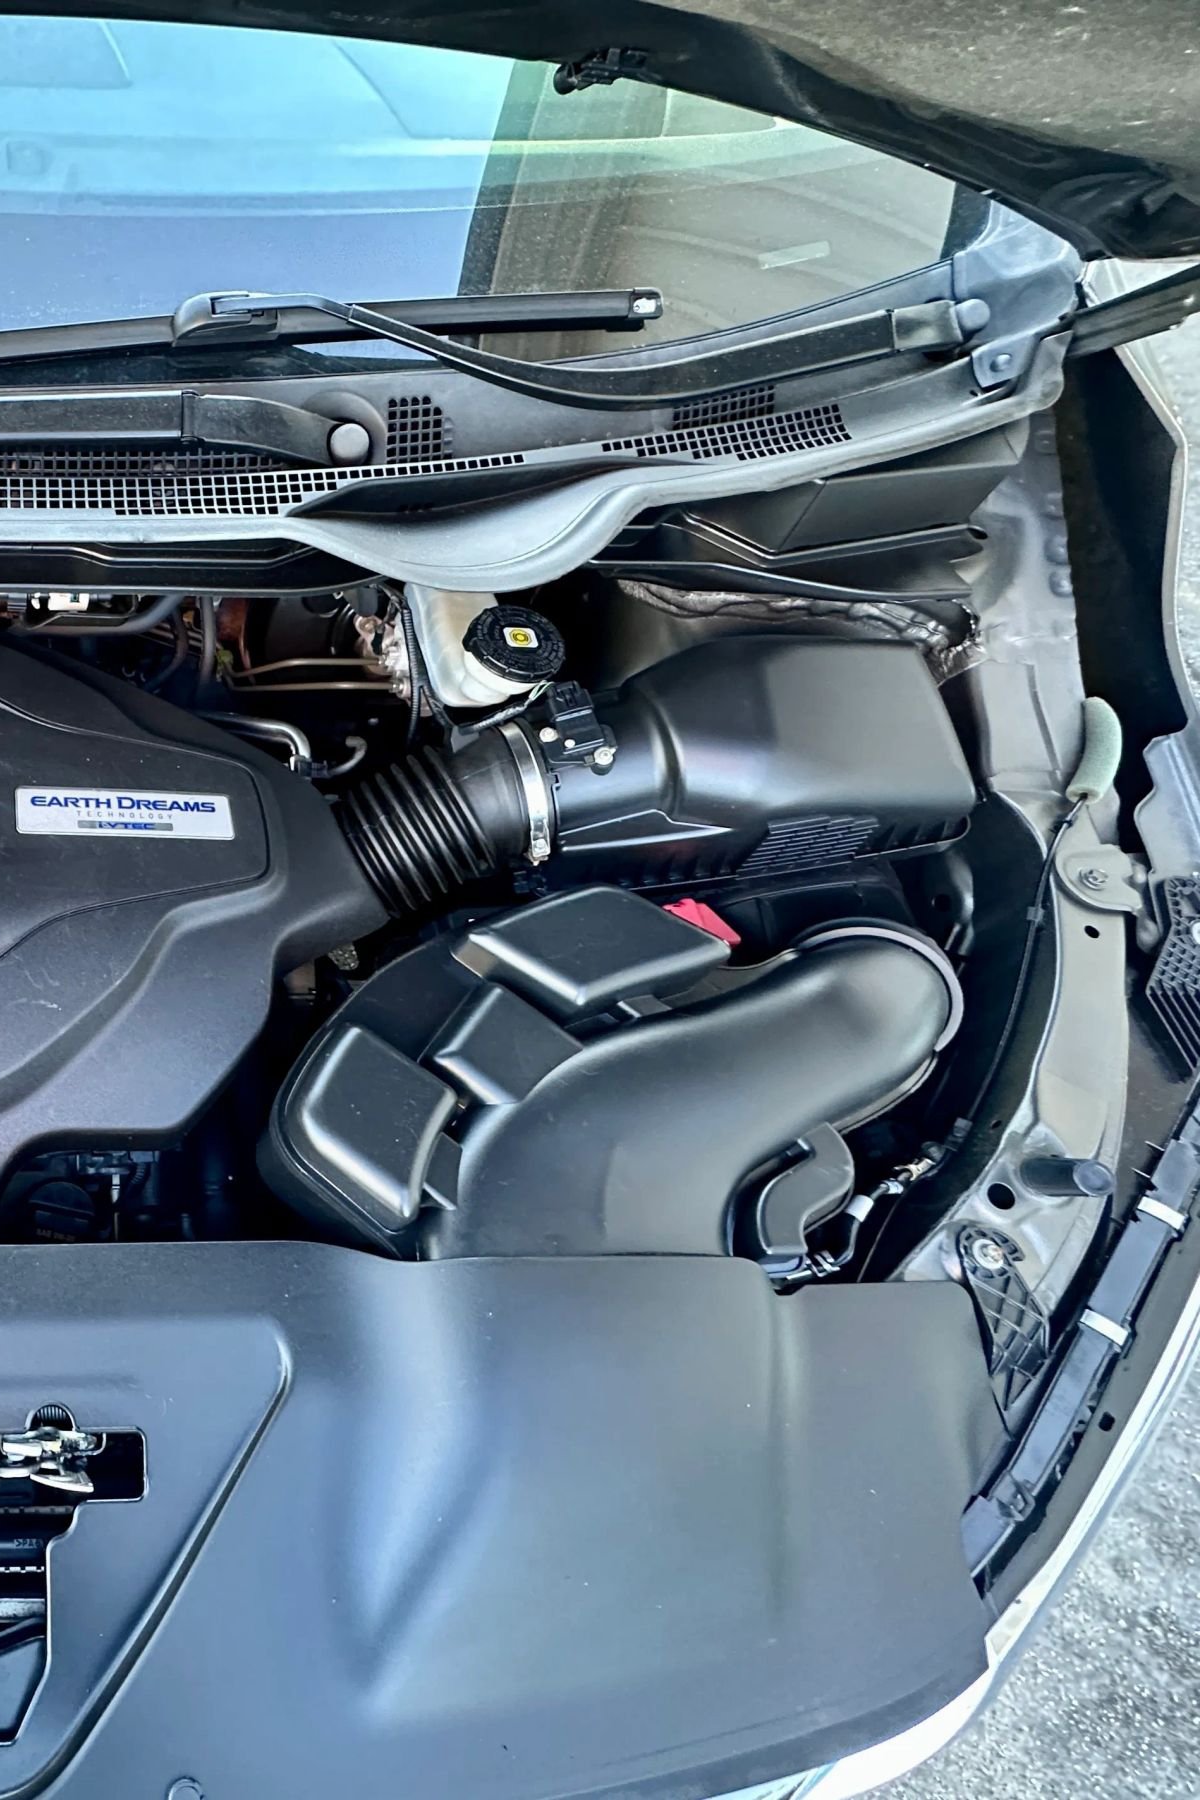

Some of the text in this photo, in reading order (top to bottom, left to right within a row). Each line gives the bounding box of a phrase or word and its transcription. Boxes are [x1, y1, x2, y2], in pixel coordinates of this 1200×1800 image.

[30, 796, 216, 813] EARTH DREAMS
[76, 810, 174, 820] TECHNOLOGY
